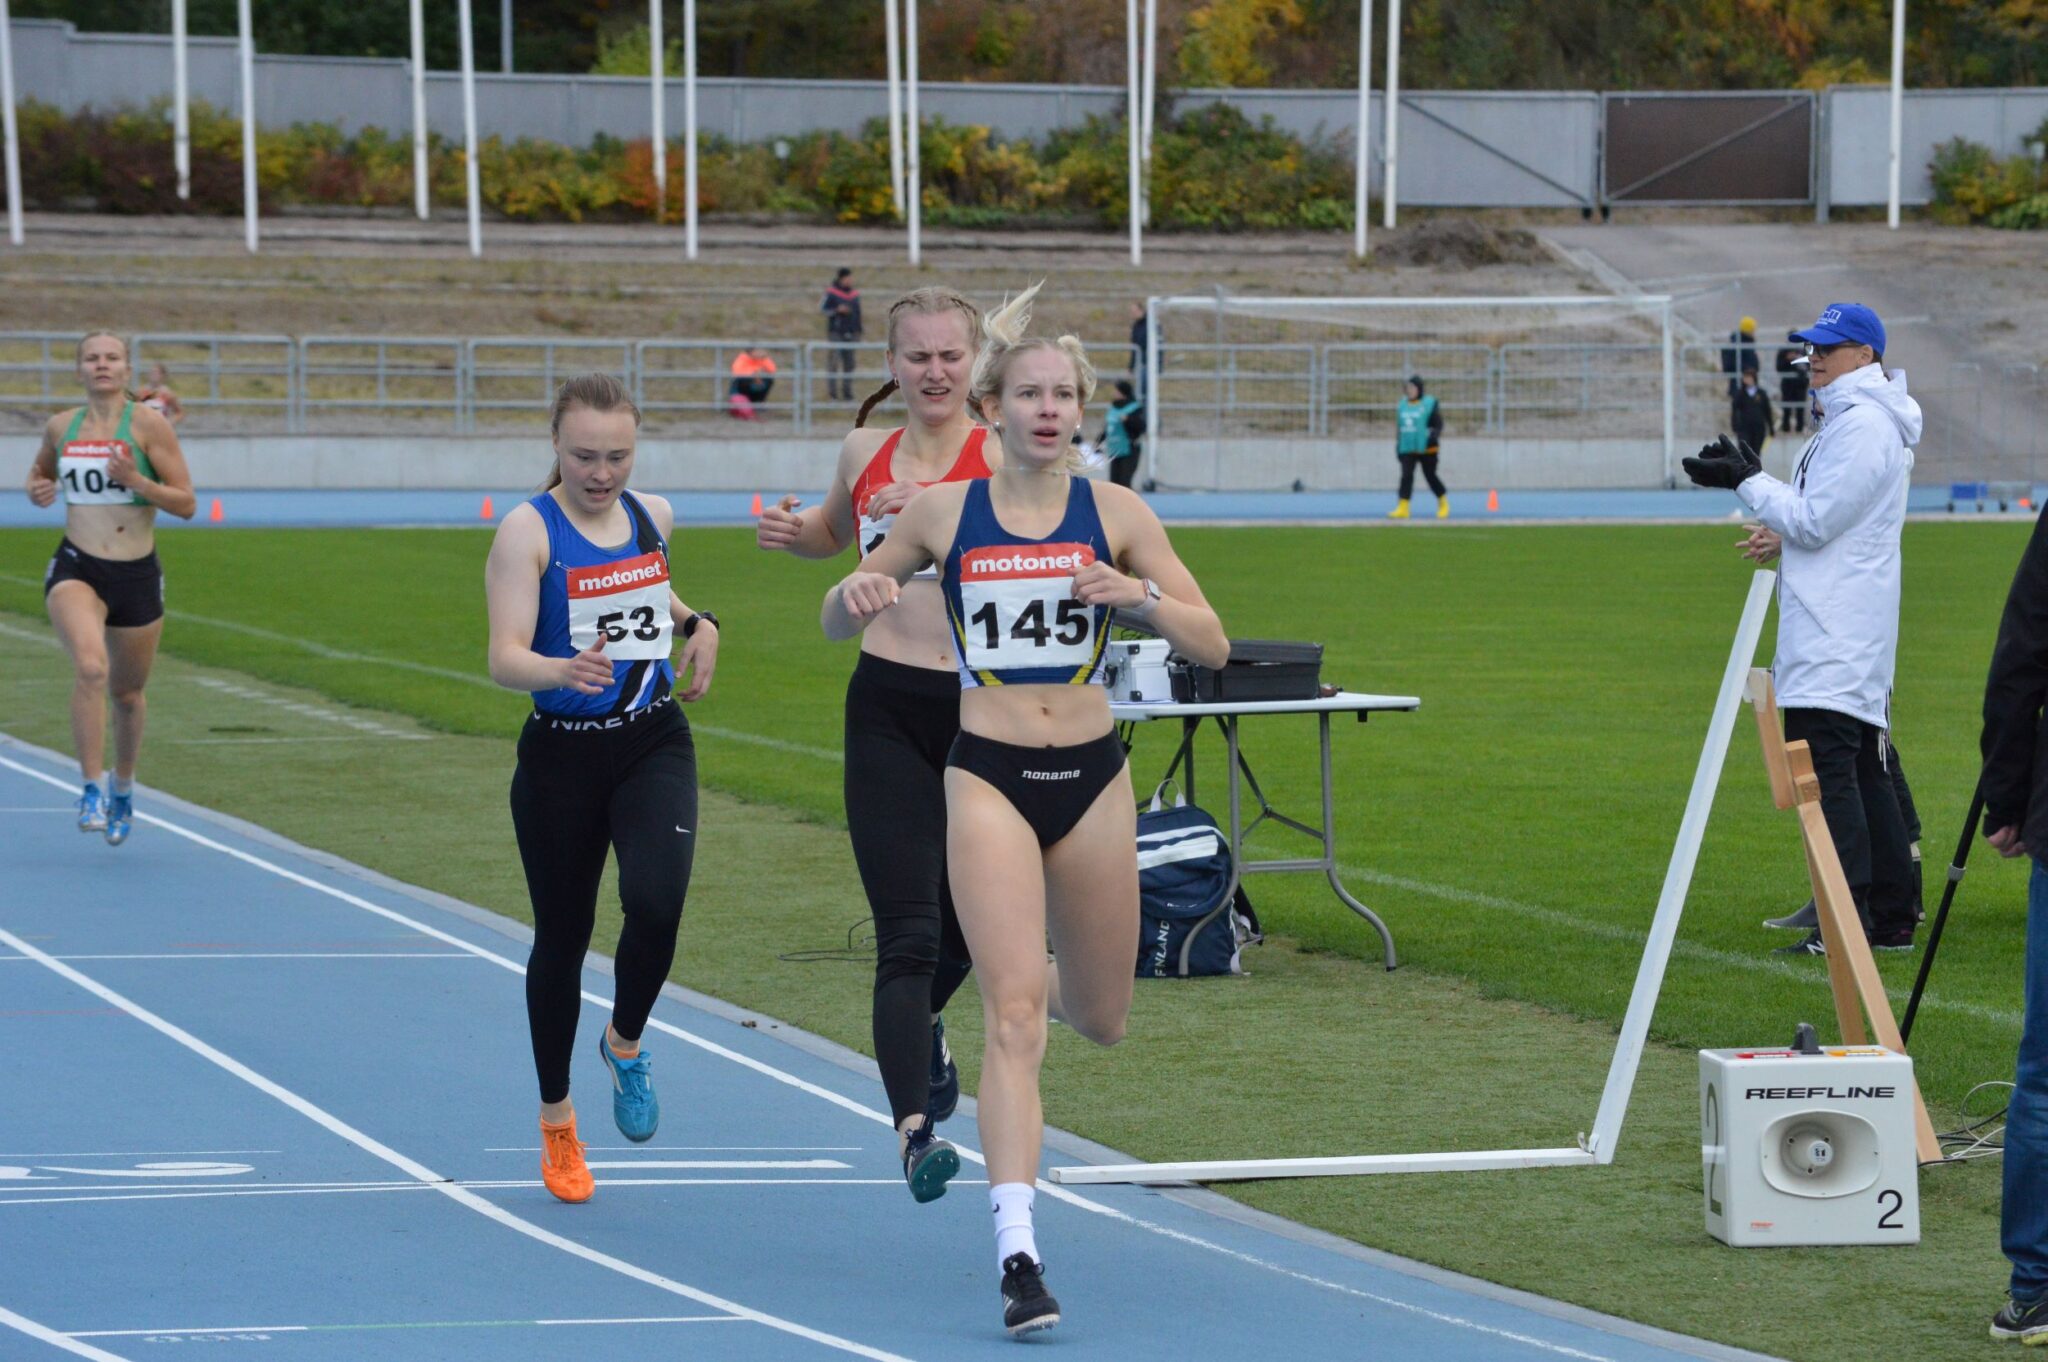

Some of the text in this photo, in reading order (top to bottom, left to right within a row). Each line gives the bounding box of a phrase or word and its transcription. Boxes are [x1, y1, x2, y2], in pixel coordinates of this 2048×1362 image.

[578, 560, 662, 592] motonet
[971, 551, 1083, 574] motonet
[596, 605, 661, 643] 53
[971, 598, 1090, 650] 145
[1745, 1086, 1895, 1100] REEFLINE
[1877, 1189, 1904, 1229] 2
